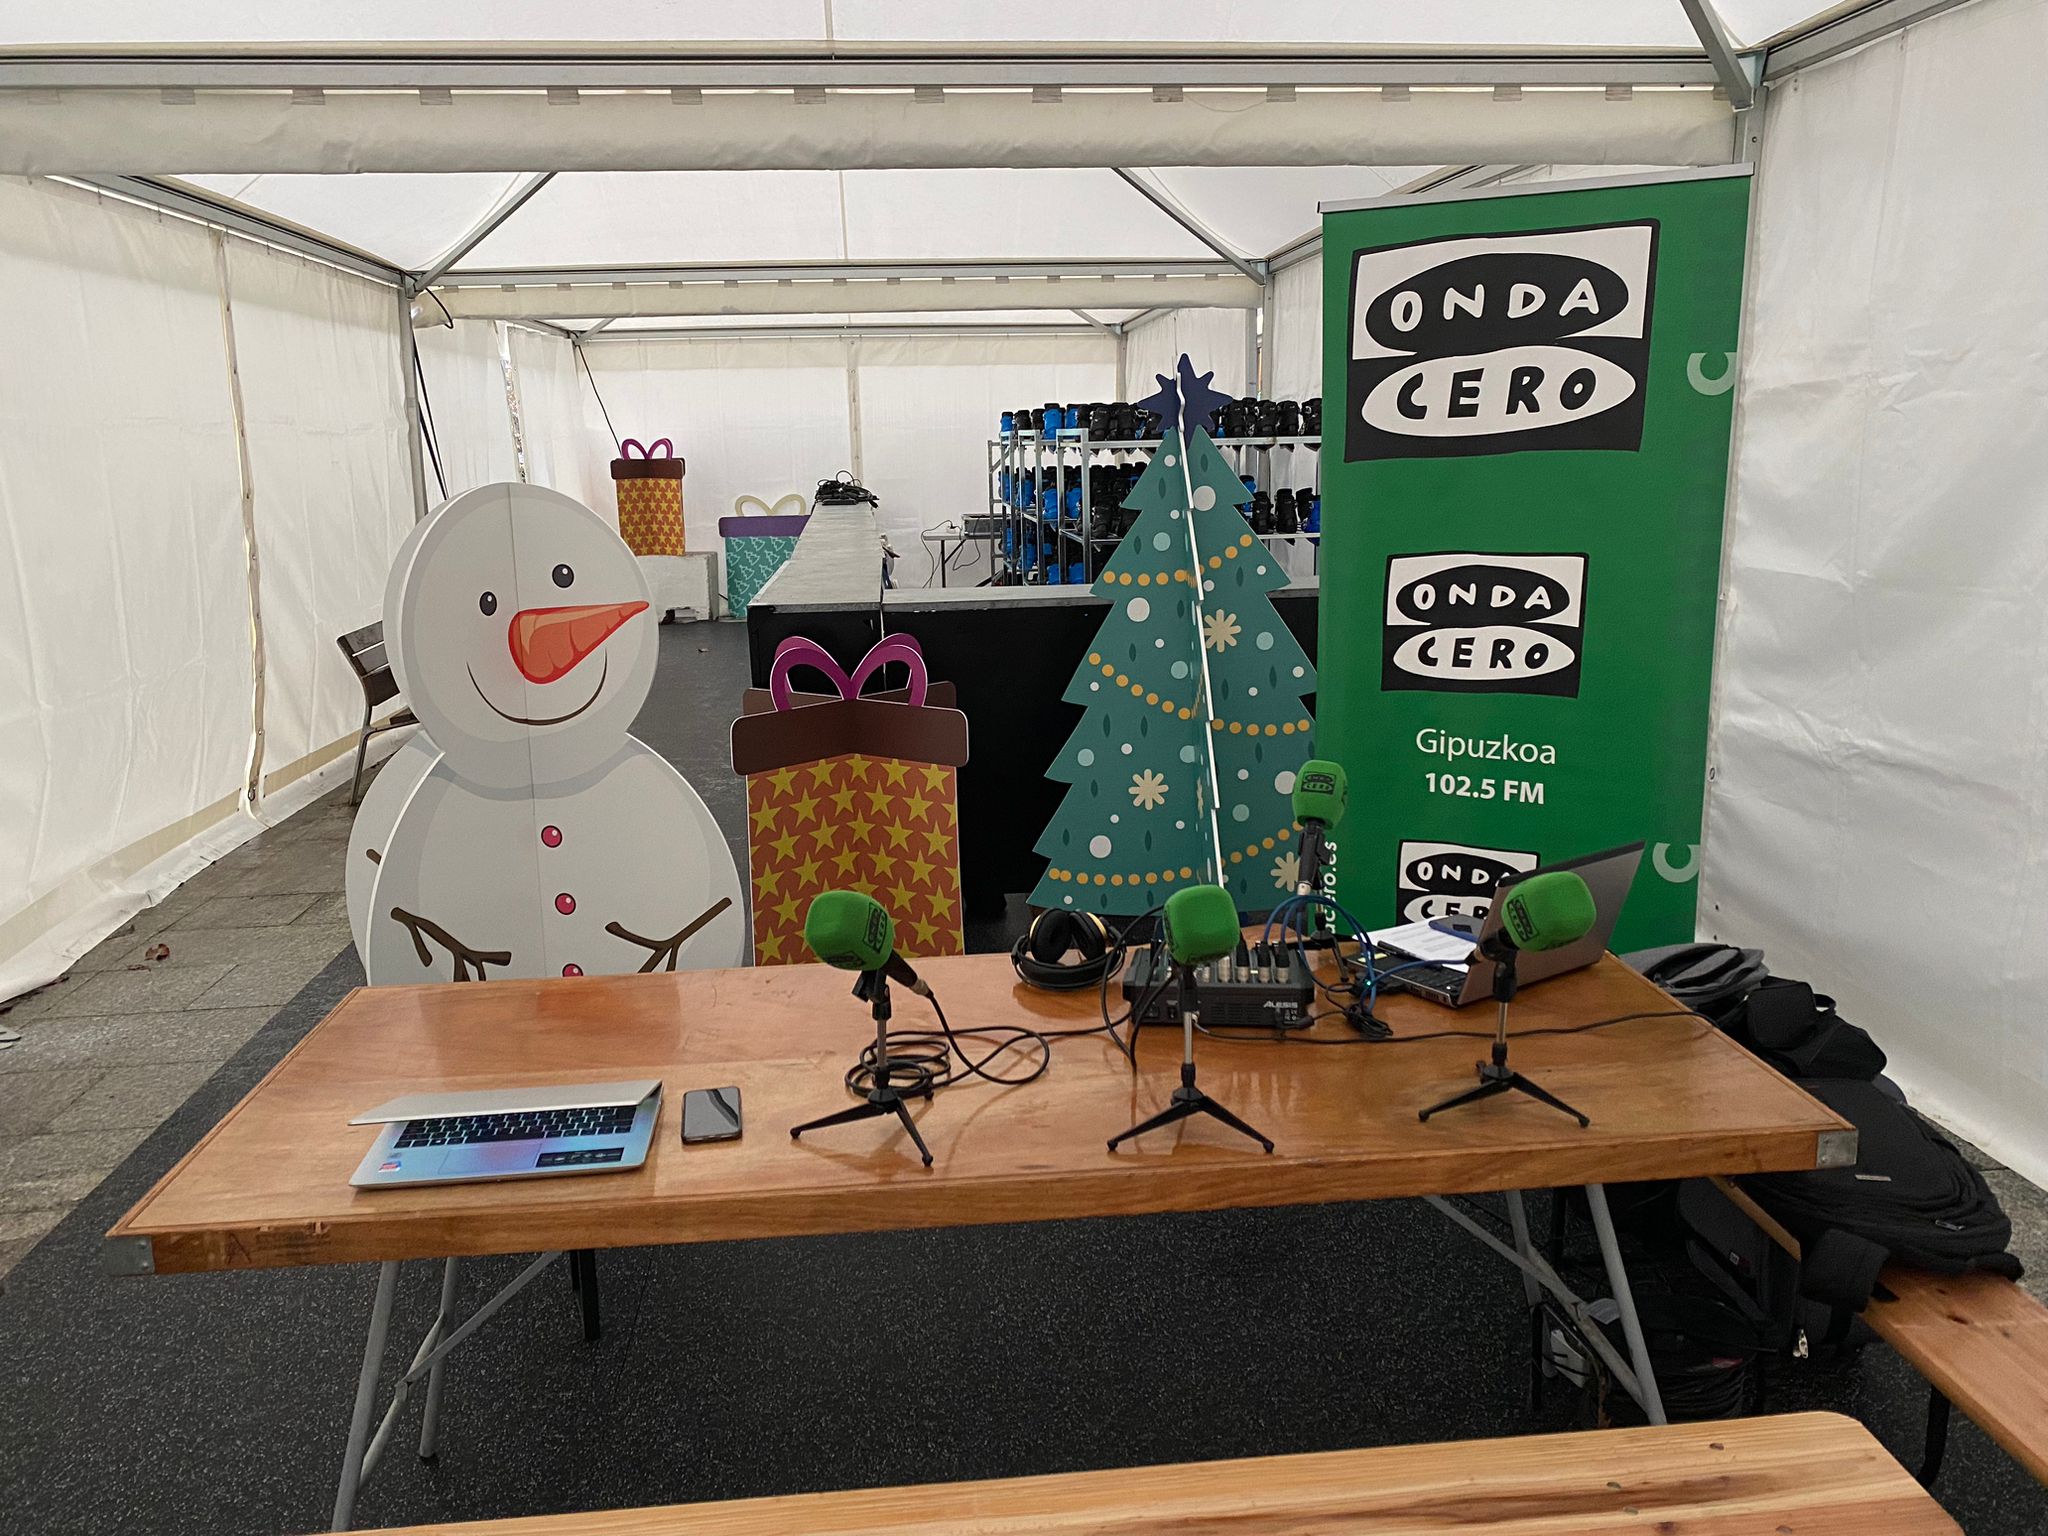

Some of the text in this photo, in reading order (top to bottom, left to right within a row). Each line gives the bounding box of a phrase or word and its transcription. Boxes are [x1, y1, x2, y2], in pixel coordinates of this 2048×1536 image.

[1390, 278, 1600, 332] ONDA
[1396, 365, 1597, 420] CERO
[1413, 583, 1552, 610] ONDA
[1417, 636, 1550, 669] CERO
[1416, 728, 1556, 764] Gipuzkoa
[1425, 773, 1544, 804] 102.5 FM
